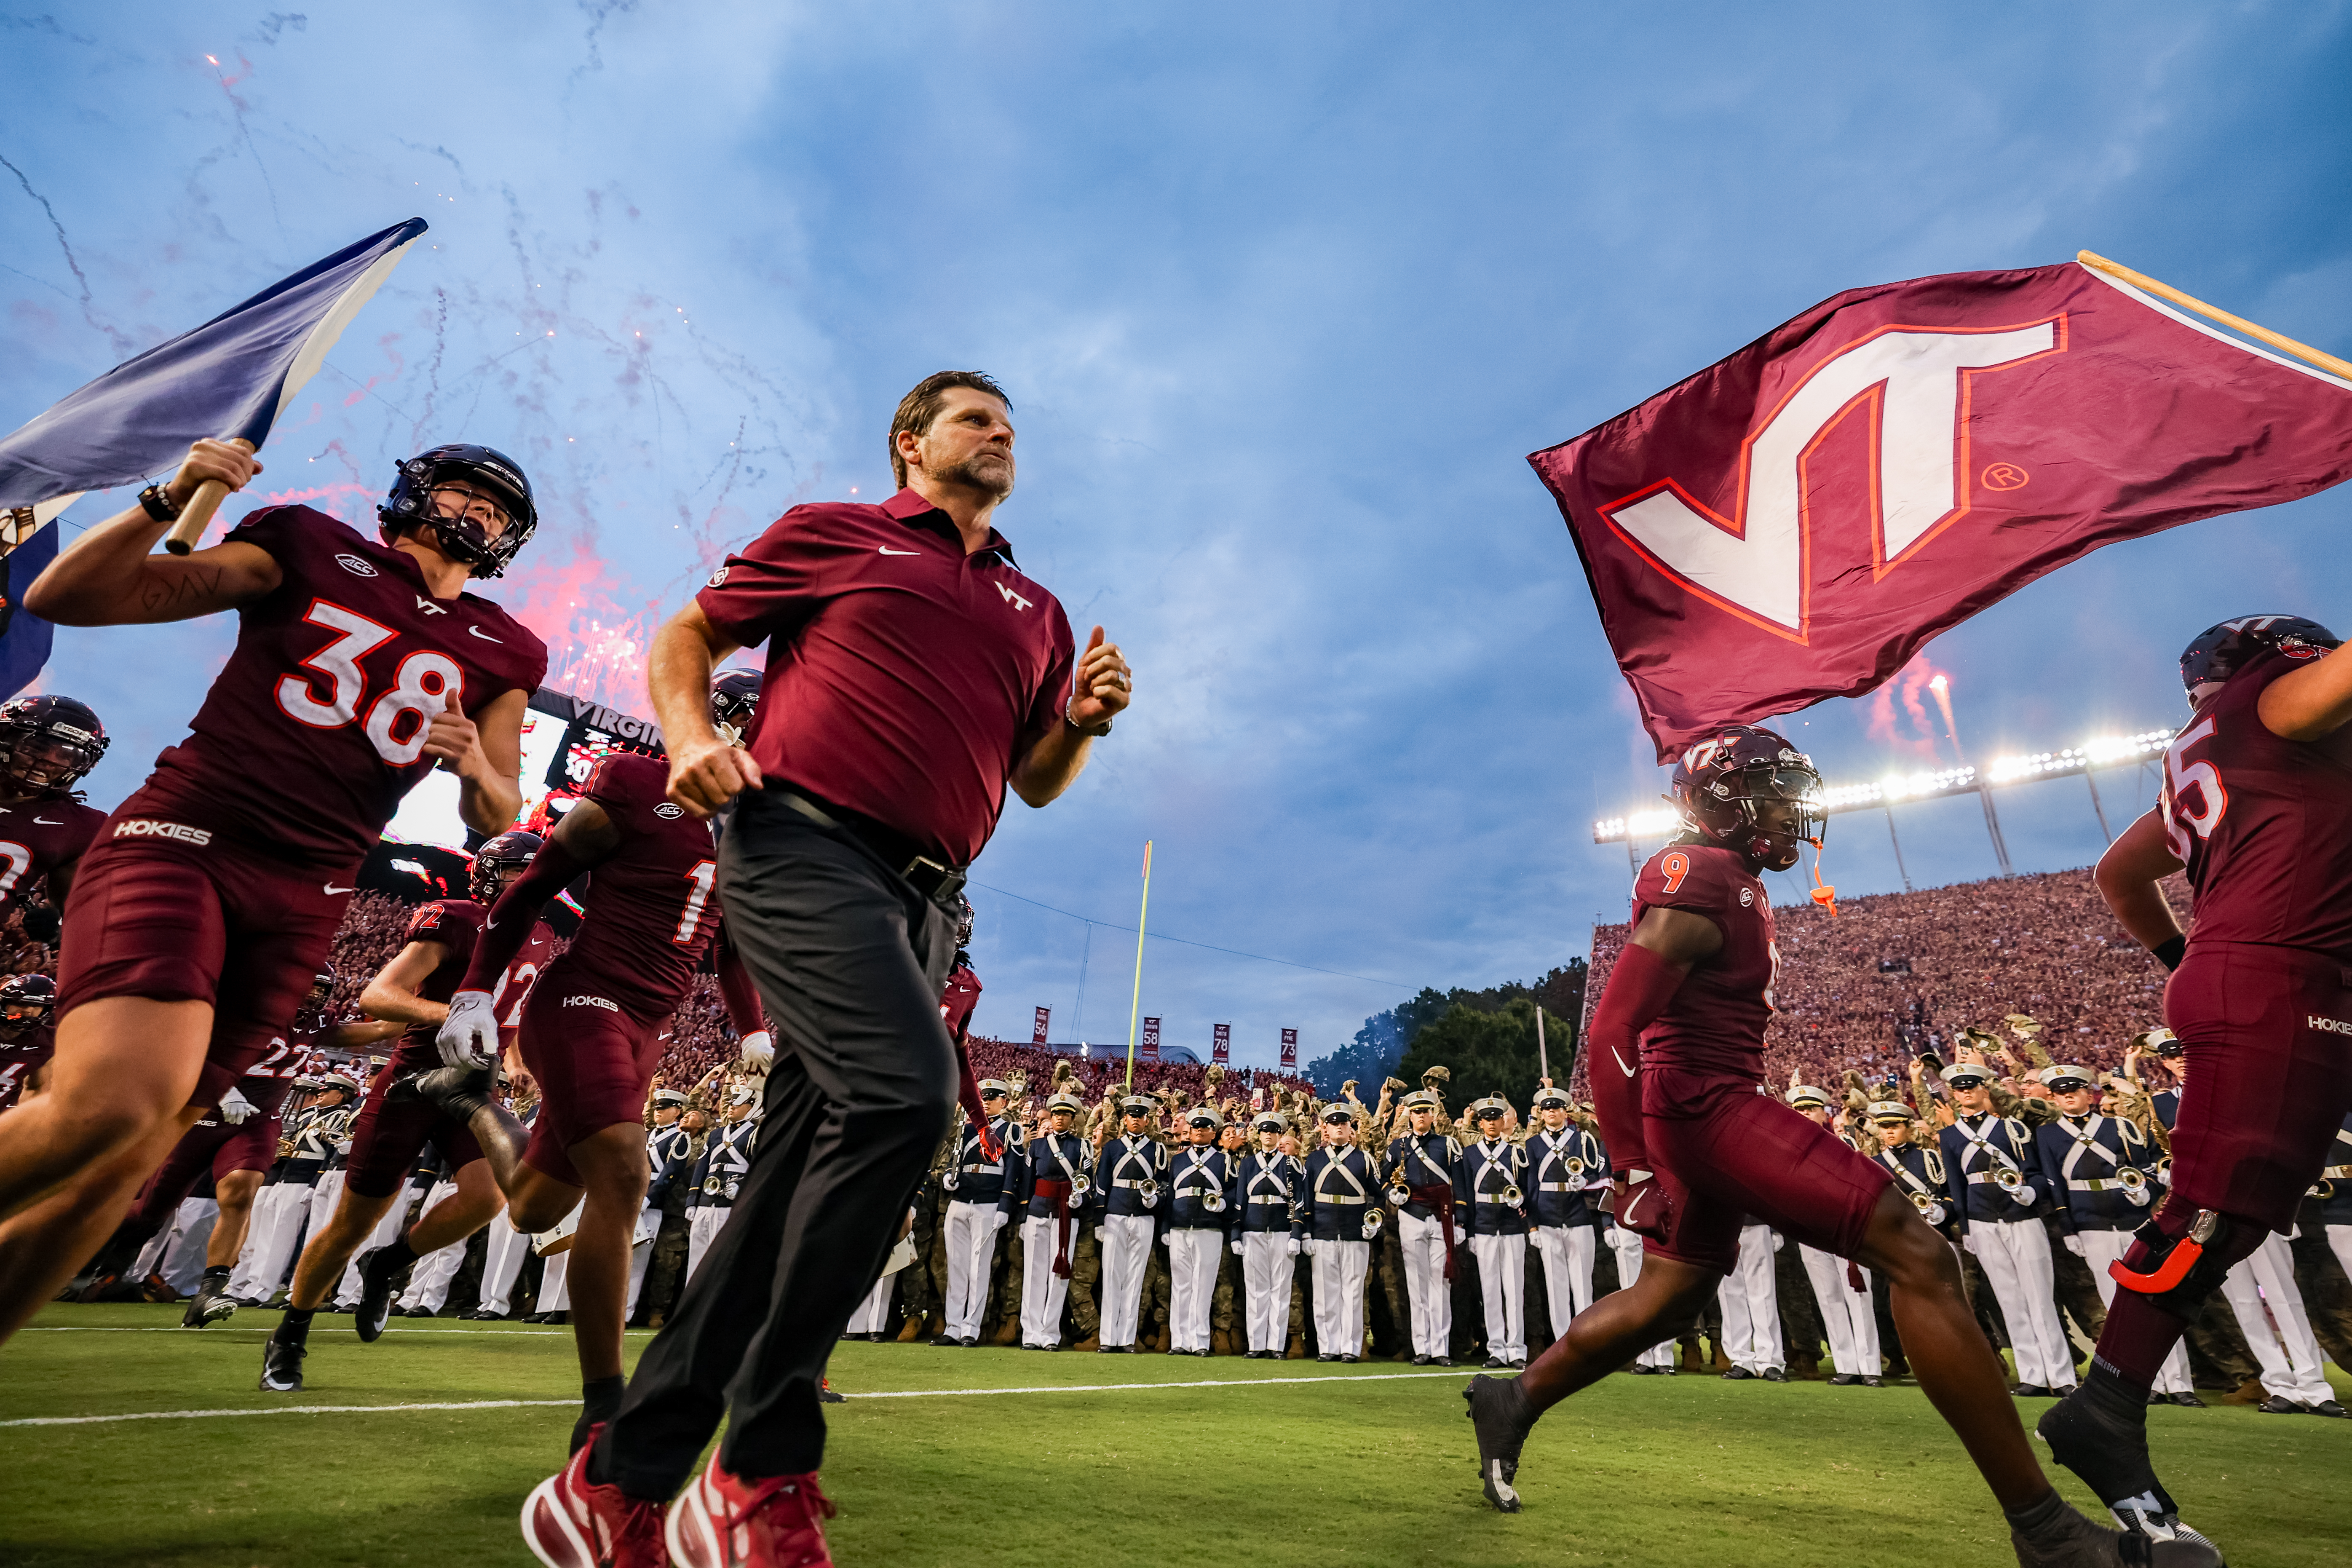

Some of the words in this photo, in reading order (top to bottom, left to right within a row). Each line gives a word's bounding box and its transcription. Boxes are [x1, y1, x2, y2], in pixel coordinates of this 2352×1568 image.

[1596, 311, 2068, 646] VT
[342, 559, 373, 574] ACC
[416, 594, 447, 615] VT
[994, 581, 1033, 611] VT
[2218, 615, 2301, 635] VT
[273, 597, 465, 768] 38
[1683, 736, 1742, 775] VT
[586, 760, 607, 794] 1
[113, 821, 212, 846] HOKIES
[1661, 852, 1690, 894] 9
[672, 859, 717, 944] 1
[409, 904, 445, 930] 92
[563, 995, 619, 1012] HOKIES
[1035, 1022, 1046, 1036] 56
[2308, 1015, 2352, 1036] HOKIE
[1144, 1032, 1158, 1045] 58
[1214, 1038, 1228, 1052] 78
[1282, 1043, 1295, 1056] 73
